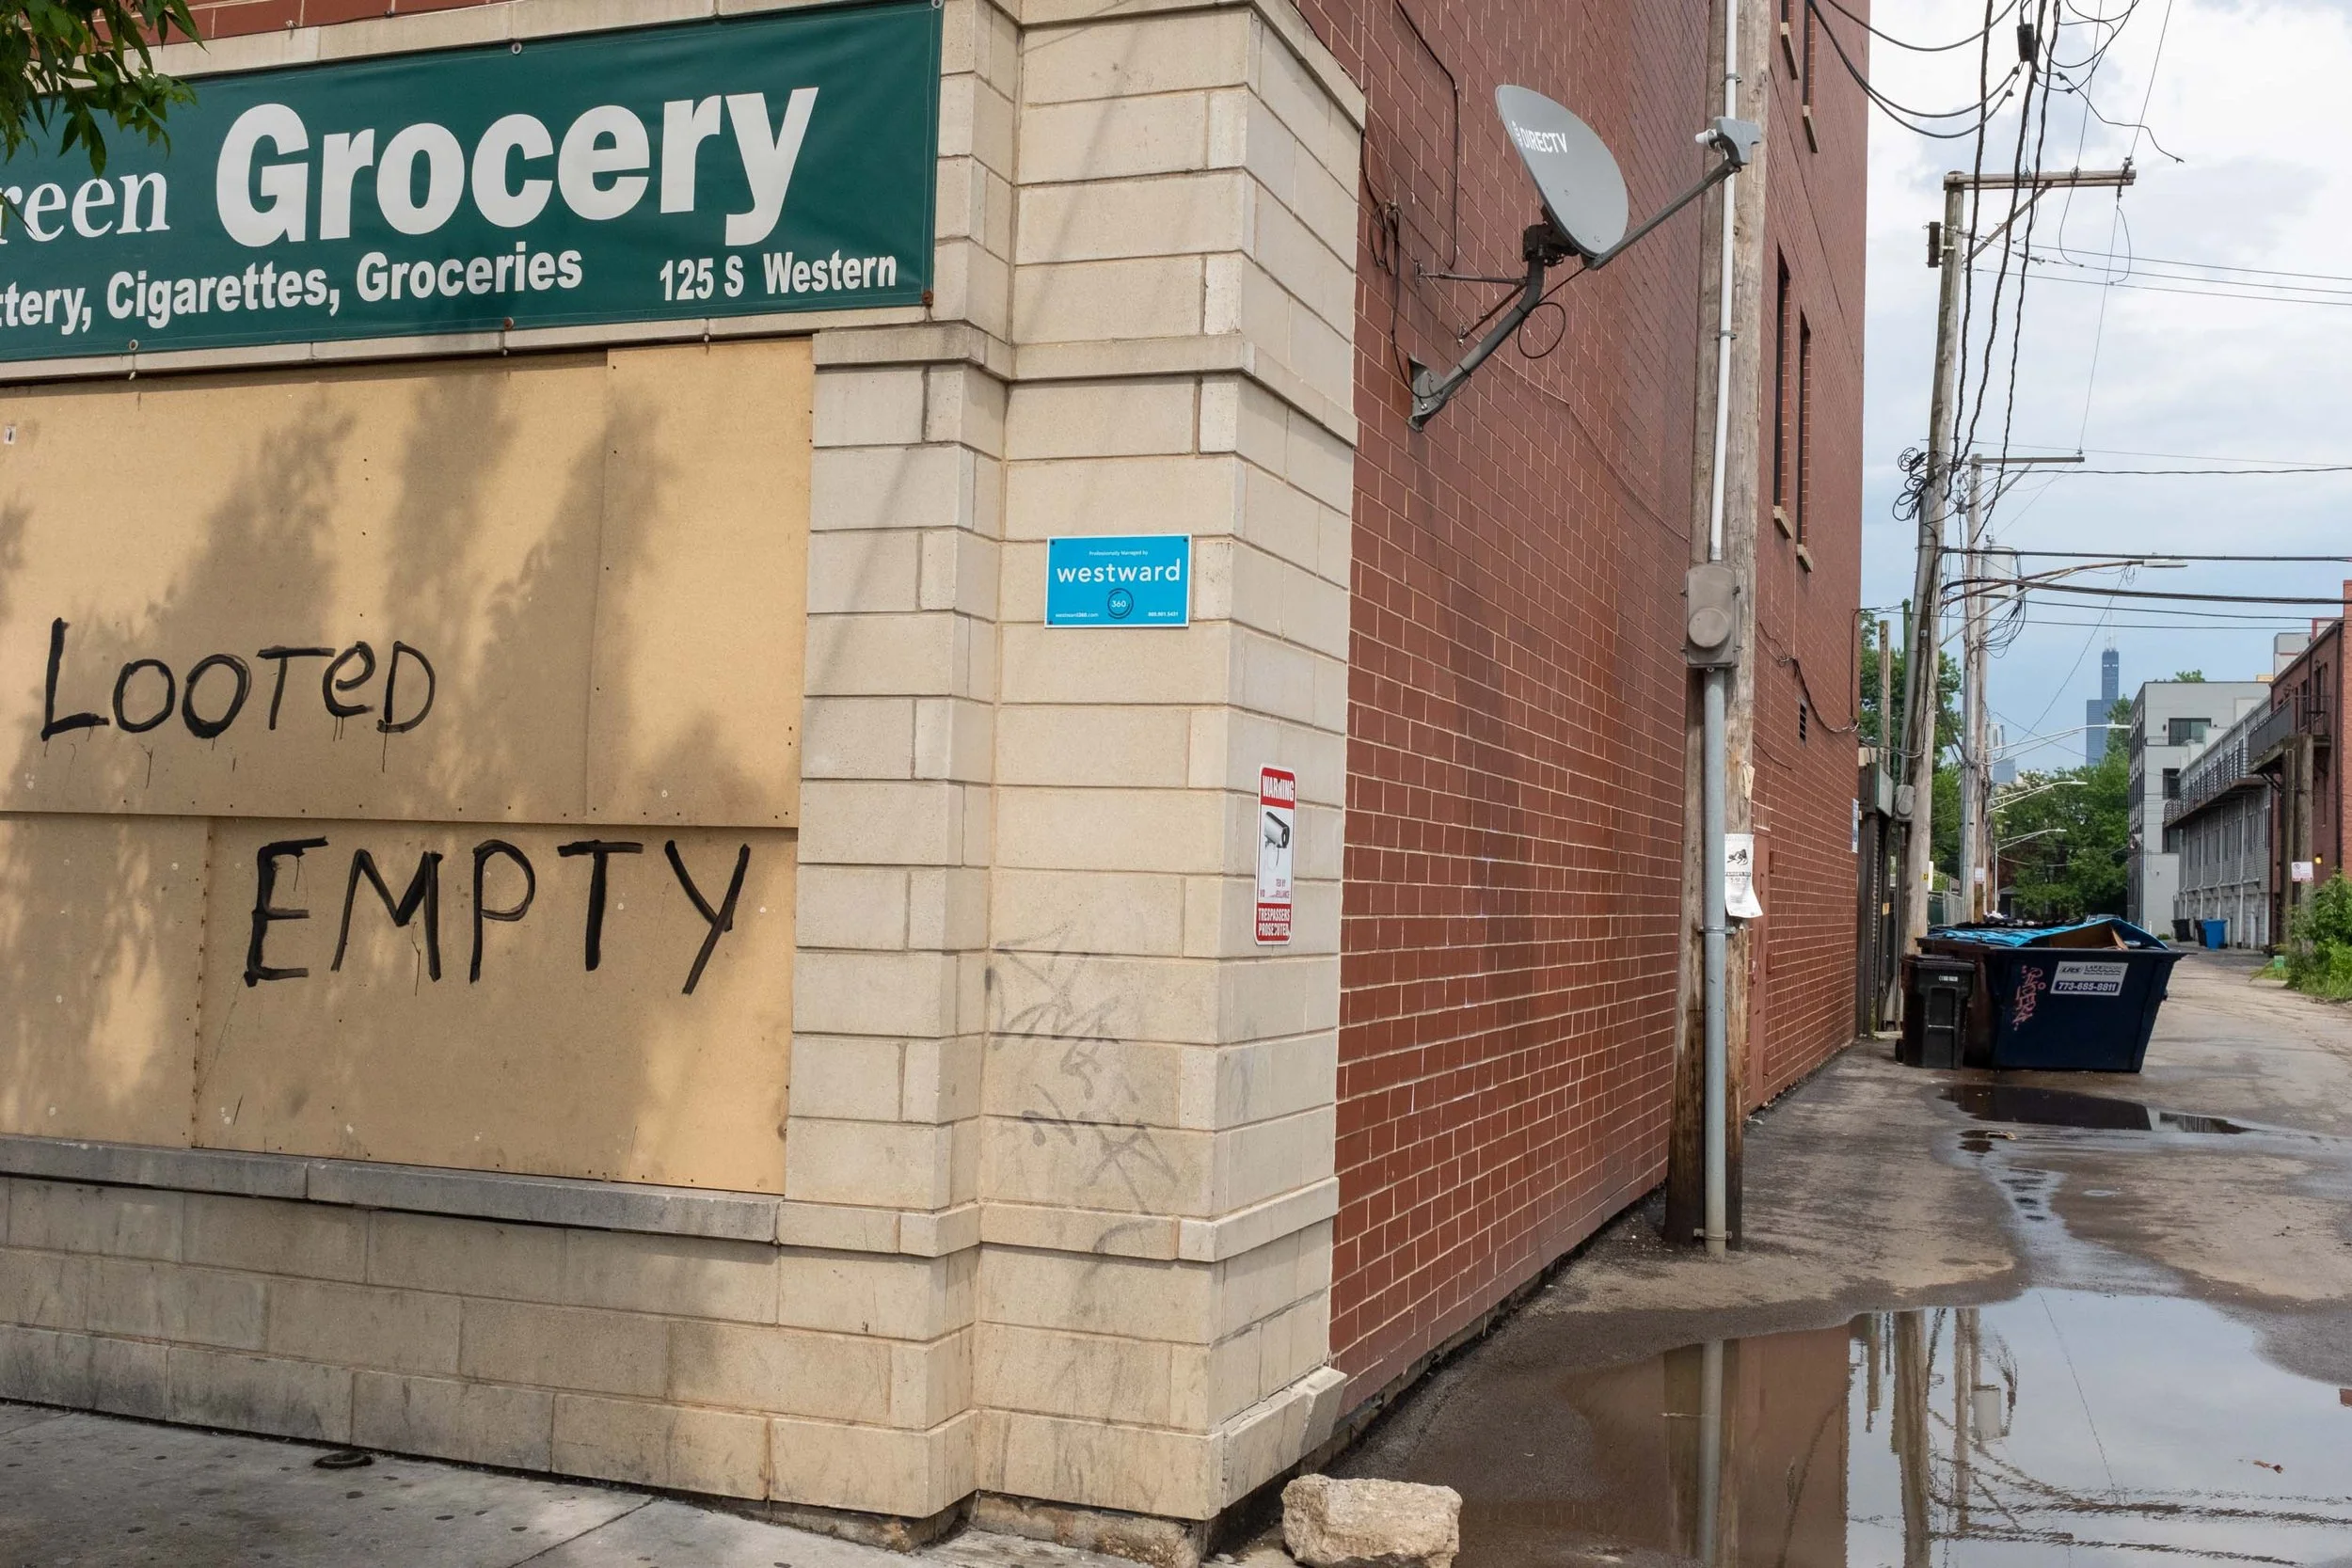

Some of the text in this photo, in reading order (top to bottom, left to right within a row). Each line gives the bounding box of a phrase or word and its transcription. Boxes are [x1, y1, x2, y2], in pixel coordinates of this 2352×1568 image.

[1519, 127, 1567, 153] DIRECTV
[216, 87, 819, 247] Grocery
[107, 261, 341, 328] Cigarettes,
[357, 242, 582, 302] Groceries
[660, 258, 714, 302] 125
[724, 256, 744, 297] S
[763, 250, 898, 294] Western
[1057, 558, 1181, 583] westward
[1111, 600, 1127, 609] 360
[1262, 775, 1295, 801] WARNING
[245, 836, 752, 995] EMPTY
[1258, 908, 1291, 922] TRESPASSERS
